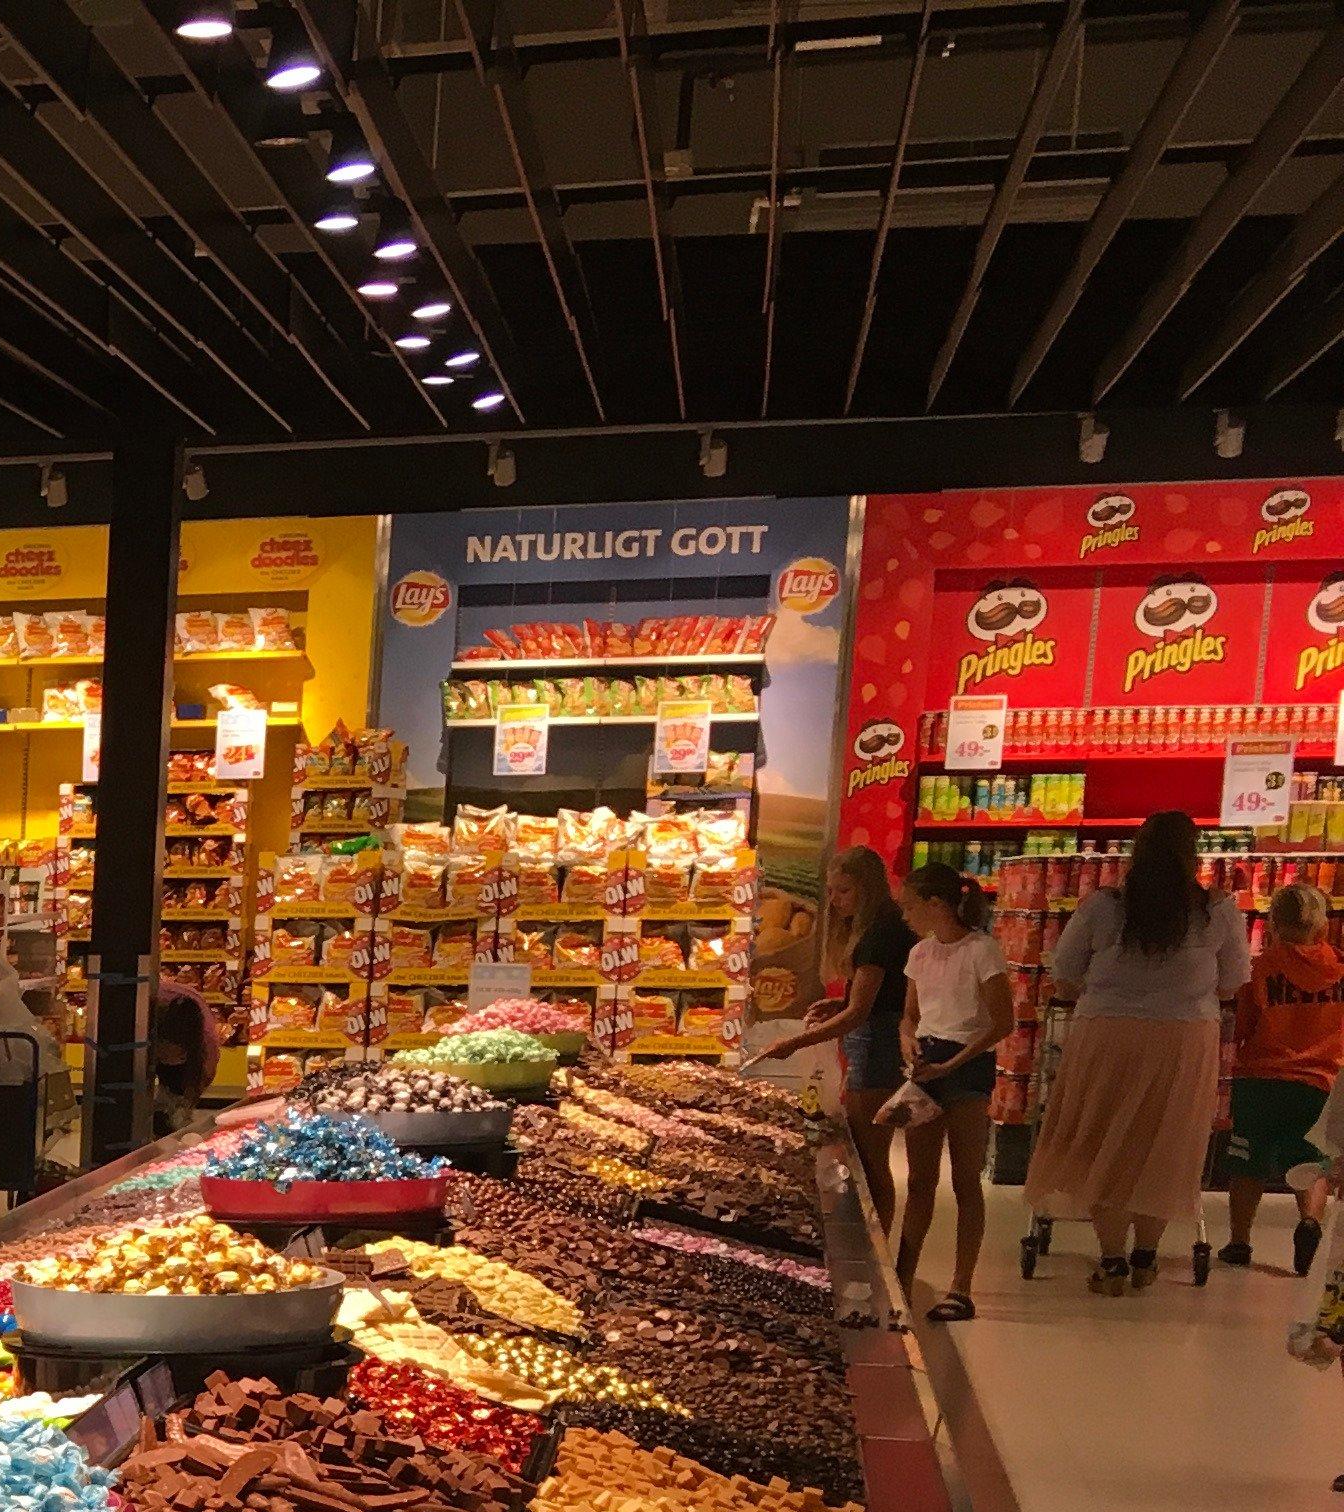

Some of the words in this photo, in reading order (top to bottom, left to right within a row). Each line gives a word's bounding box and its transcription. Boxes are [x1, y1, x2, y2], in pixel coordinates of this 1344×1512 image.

[466, 529, 663, 564] NATURLIGT
[670, 524, 769, 557] GOTT
[1079, 524, 1140, 558] Pringles
[1253, 518, 1315, 554] Pringles
[958, 634, 1056, 695] Pringles
[1124, 631, 1226, 694] Pringles
[847, 757, 910, 798] Pringles
